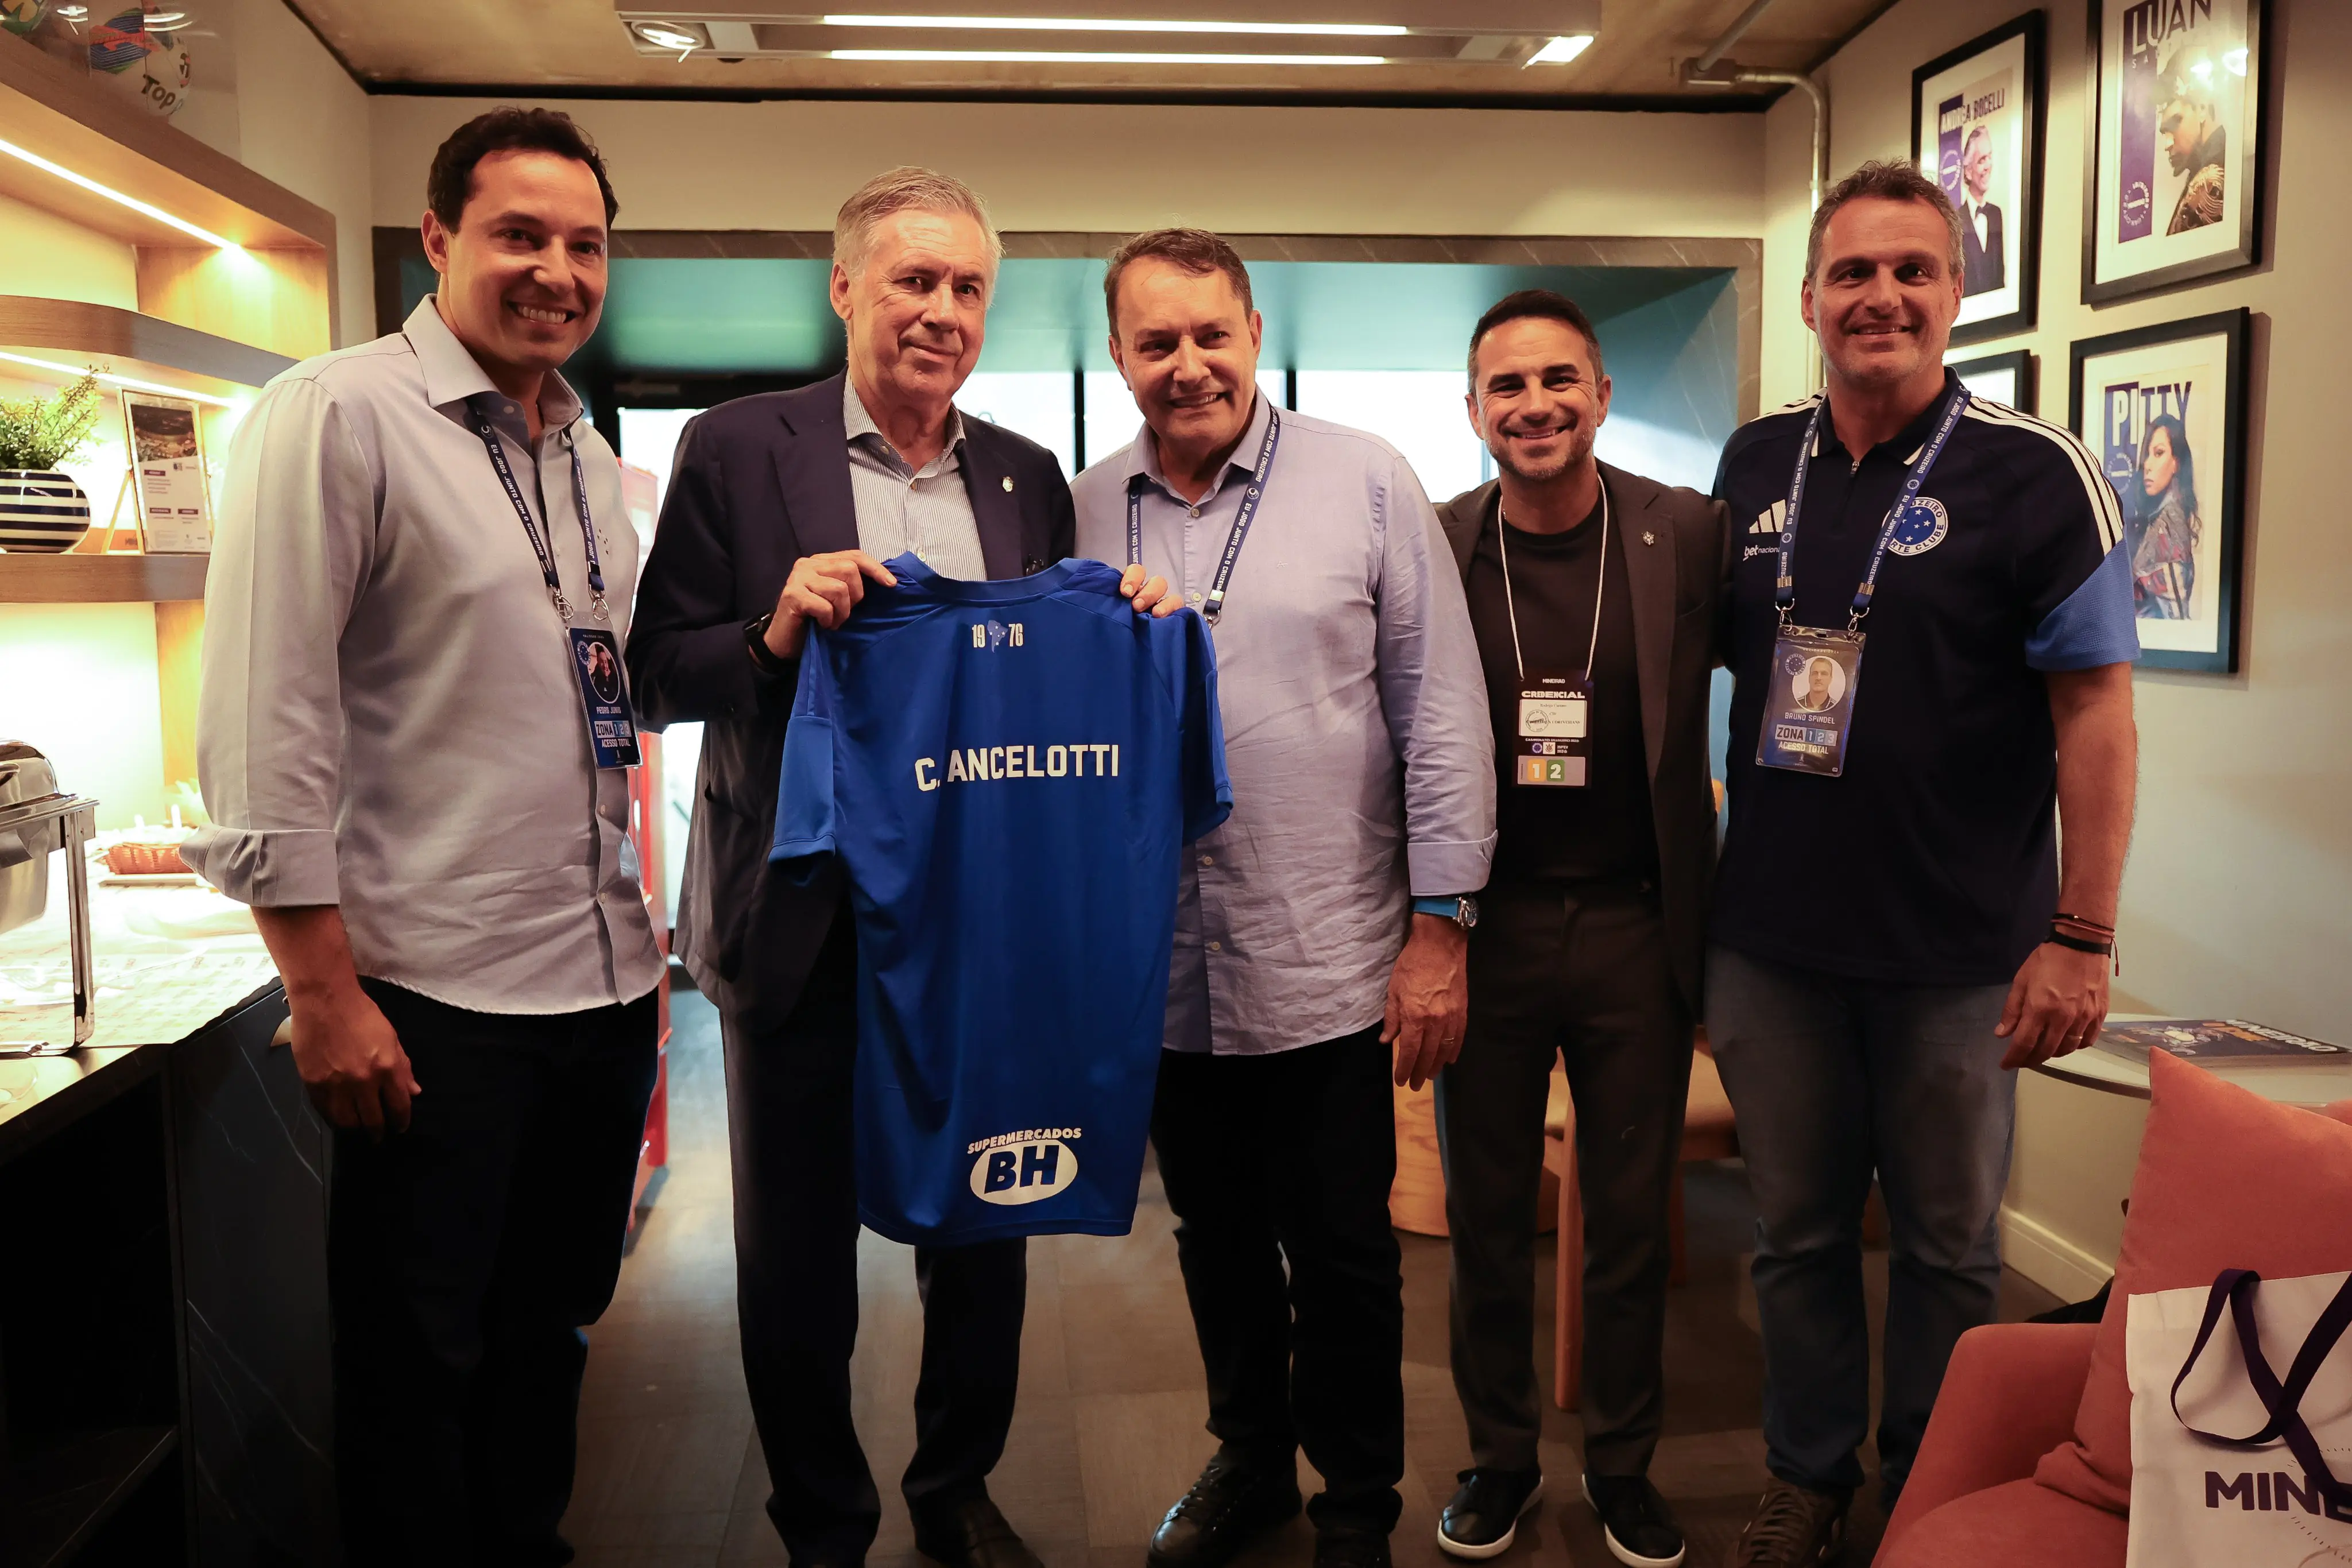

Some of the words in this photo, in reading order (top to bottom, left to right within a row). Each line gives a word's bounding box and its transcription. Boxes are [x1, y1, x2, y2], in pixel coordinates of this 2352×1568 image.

[2132, 0, 2211, 55] LUAN
[141, 73, 176, 110] Top
[1950, 402, 1961, 416] JOGO
[2113, 381, 2192, 447] PITTY
[1941, 415, 1953, 432] JUNTO
[1268, 424, 1276, 441] JUNTO
[1934, 432, 1945, 444] COM
[1264, 440, 1273, 452] COM
[1255, 456, 1268, 483] CRUZEIRO
[1917, 448, 1935, 474] CRUZEIRO
[1792, 484, 1800, 502] JUNTO
[1798, 441, 1808, 466] CRUZEIRO
[491, 444, 499, 454] EU
[496, 456, 507, 474] JOGO
[504, 476, 518, 498] JUNTO
[516, 500, 526, 514] COM
[527, 522, 544, 556] CRUZEIRO
[1244, 502, 1252, 512] EU
[1902, 495, 1910, 503] EU
[1894, 503, 1905, 518] JOGO
[1238, 512, 1248, 527] JOGO
[1884, 518, 1897, 536] JUNTO
[1231, 527, 1242, 546] JUNTO
[1878, 537, 1888, 550] COM
[1916, 524, 1944, 551] CLUBE
[1226, 547, 1236, 559] COM
[1867, 556, 1881, 585] CRUZEIRO
[972, 624, 985, 648] 19
[1008, 623, 1023, 647] 76
[1521, 691, 1585, 699] CREDENCIAL
[1785, 712, 1806, 721] BRUNO
[1808, 714, 1835, 725] SPINDEL
[596, 723, 614, 736] ZONA
[614, 723, 618, 735] 1
[619, 723, 625, 735] 2
[1777, 727, 1804, 741] ZONA
[1809, 730, 1813, 741] 1
[1817, 732, 1824, 742] 2
[1828, 733, 1835, 744] 3
[602, 738, 618, 748] ACESSO
[617, 738, 631, 747] TOTAL
[1778, 741, 1806, 752] ACESSO
[1809, 744, 1829, 754] TOTAL
[915, 757, 941, 792] C.
[947, 744, 1119, 783] ANCELOTTI
[1532, 764, 1540, 779] 1
[1550, 764, 1561, 779] 2
[967, 1128, 1082, 1154] SUPERMERCADOS
[984, 1145, 1060, 1195] BH
